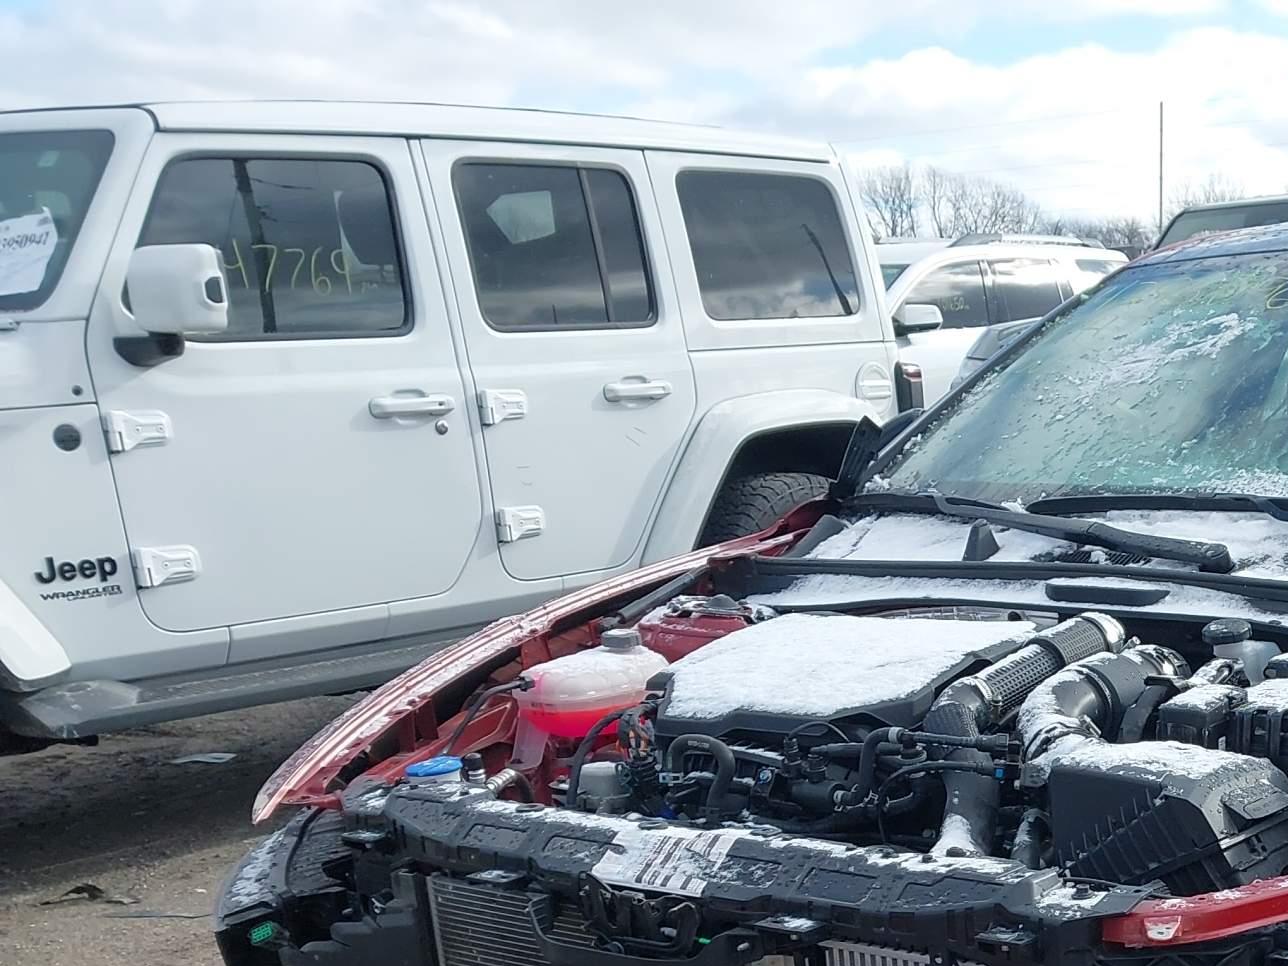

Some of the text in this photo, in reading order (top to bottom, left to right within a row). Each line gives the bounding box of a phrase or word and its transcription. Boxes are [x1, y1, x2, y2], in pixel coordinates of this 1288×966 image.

[0, 231, 50, 249] 3950947
[34, 556, 118, 584] Jeep
[39, 584, 123, 600] WRANGLER
